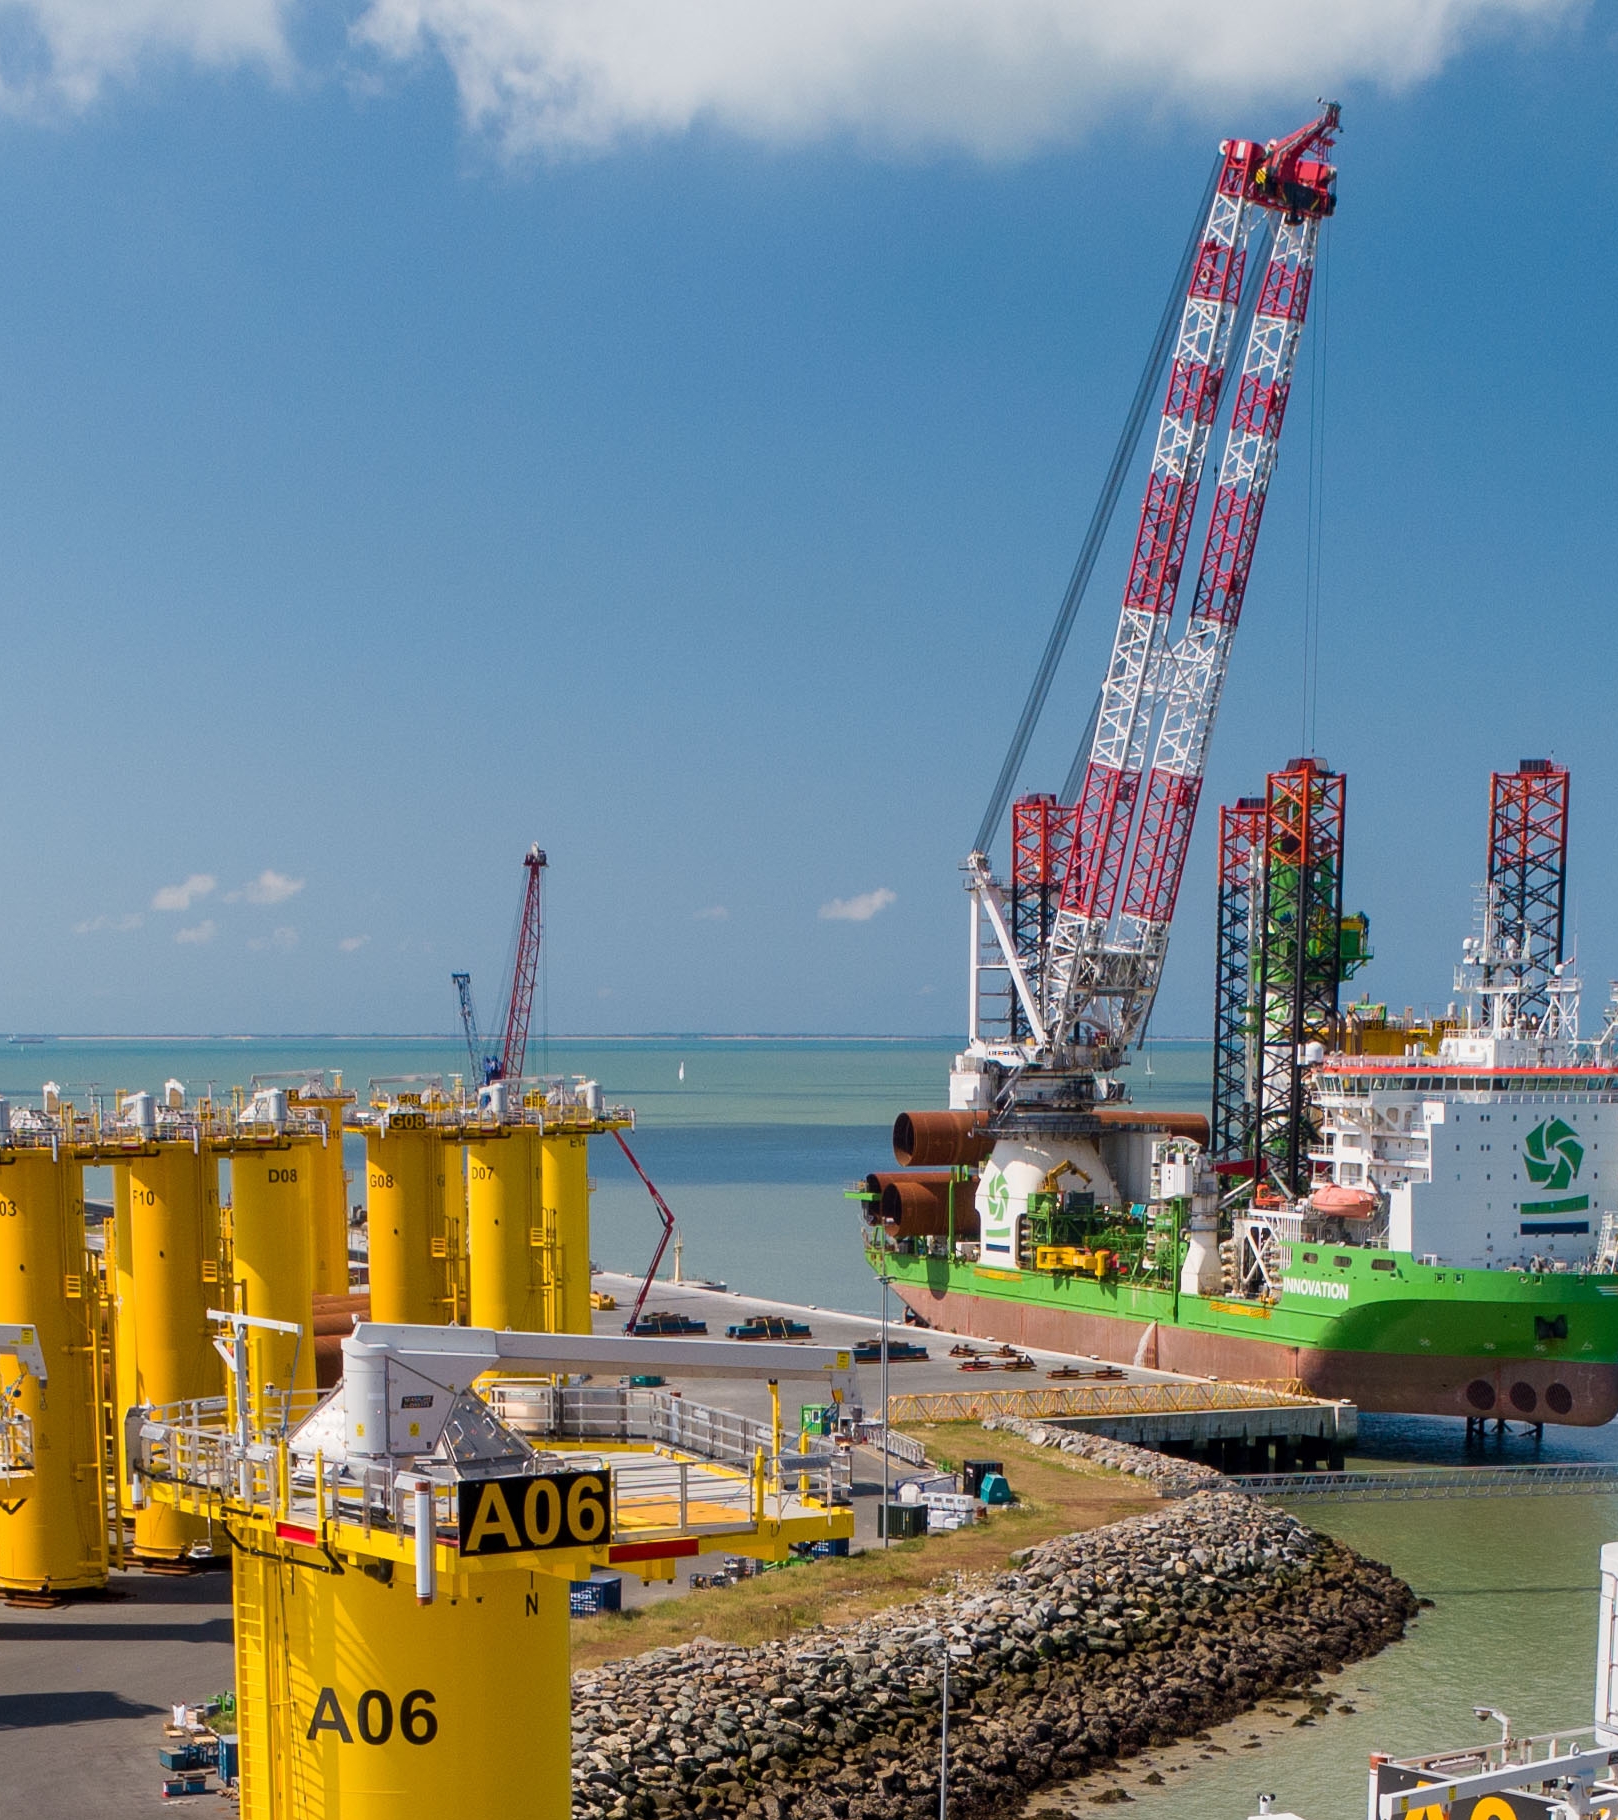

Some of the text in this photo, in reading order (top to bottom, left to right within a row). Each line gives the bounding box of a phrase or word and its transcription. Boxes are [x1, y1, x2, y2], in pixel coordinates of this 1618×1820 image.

[1434, 1020, 1456, 1030] E10
[390, 1114, 425, 1129] G08
[268, 1169, 298, 1183] D08
[370, 1174, 394, 1188] G08
[471, 1167, 494, 1180] D07
[133, 1190, 154, 1206] F10
[1283, 1277, 1349, 1300] INNOVATION
[464, 1476, 606, 1552] A06
[525, 1592, 538, 1617] N
[306, 1687, 438, 1745] A06
